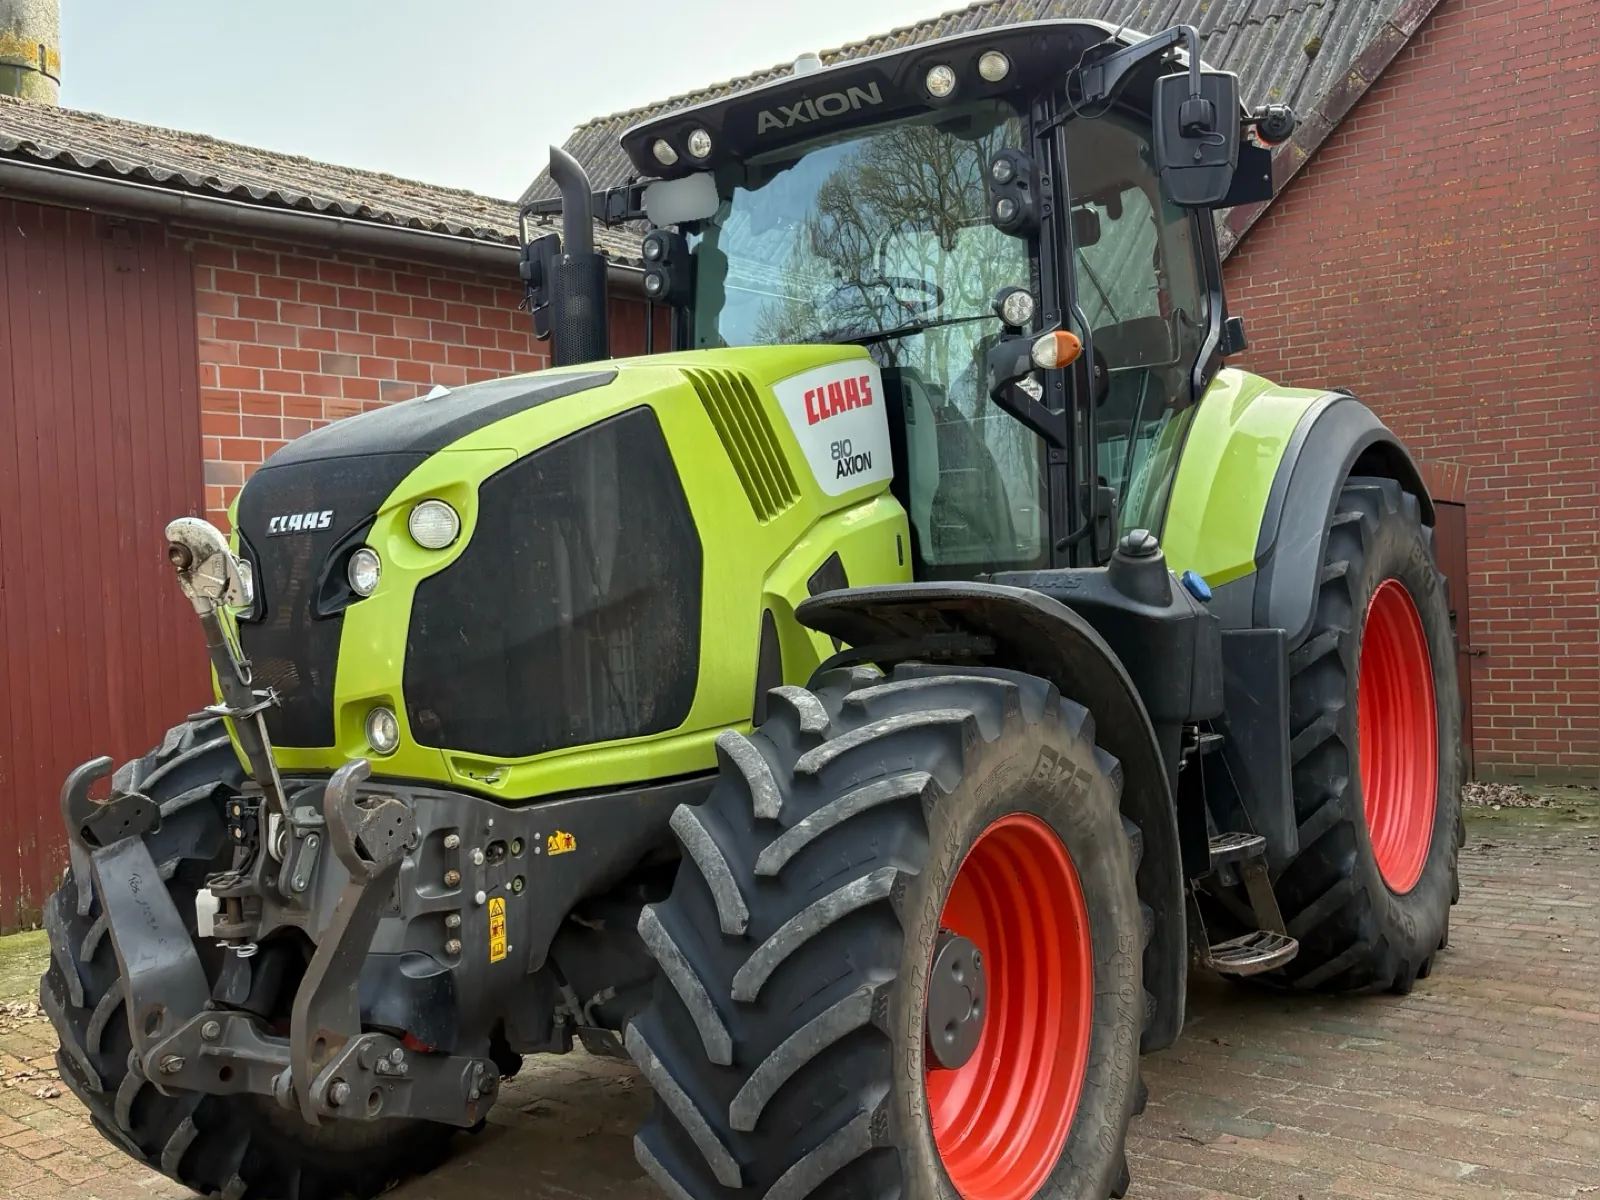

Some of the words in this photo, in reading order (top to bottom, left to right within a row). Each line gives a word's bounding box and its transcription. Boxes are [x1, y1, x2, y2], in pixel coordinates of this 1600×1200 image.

[757, 81, 883, 134] AXION
[804, 375, 873, 426] CLAAS
[830, 438, 852, 460] 810
[836, 451, 872, 479] AXION
[268, 510, 333, 533] CLAAS
[1028, 745, 1092, 808] BKT
